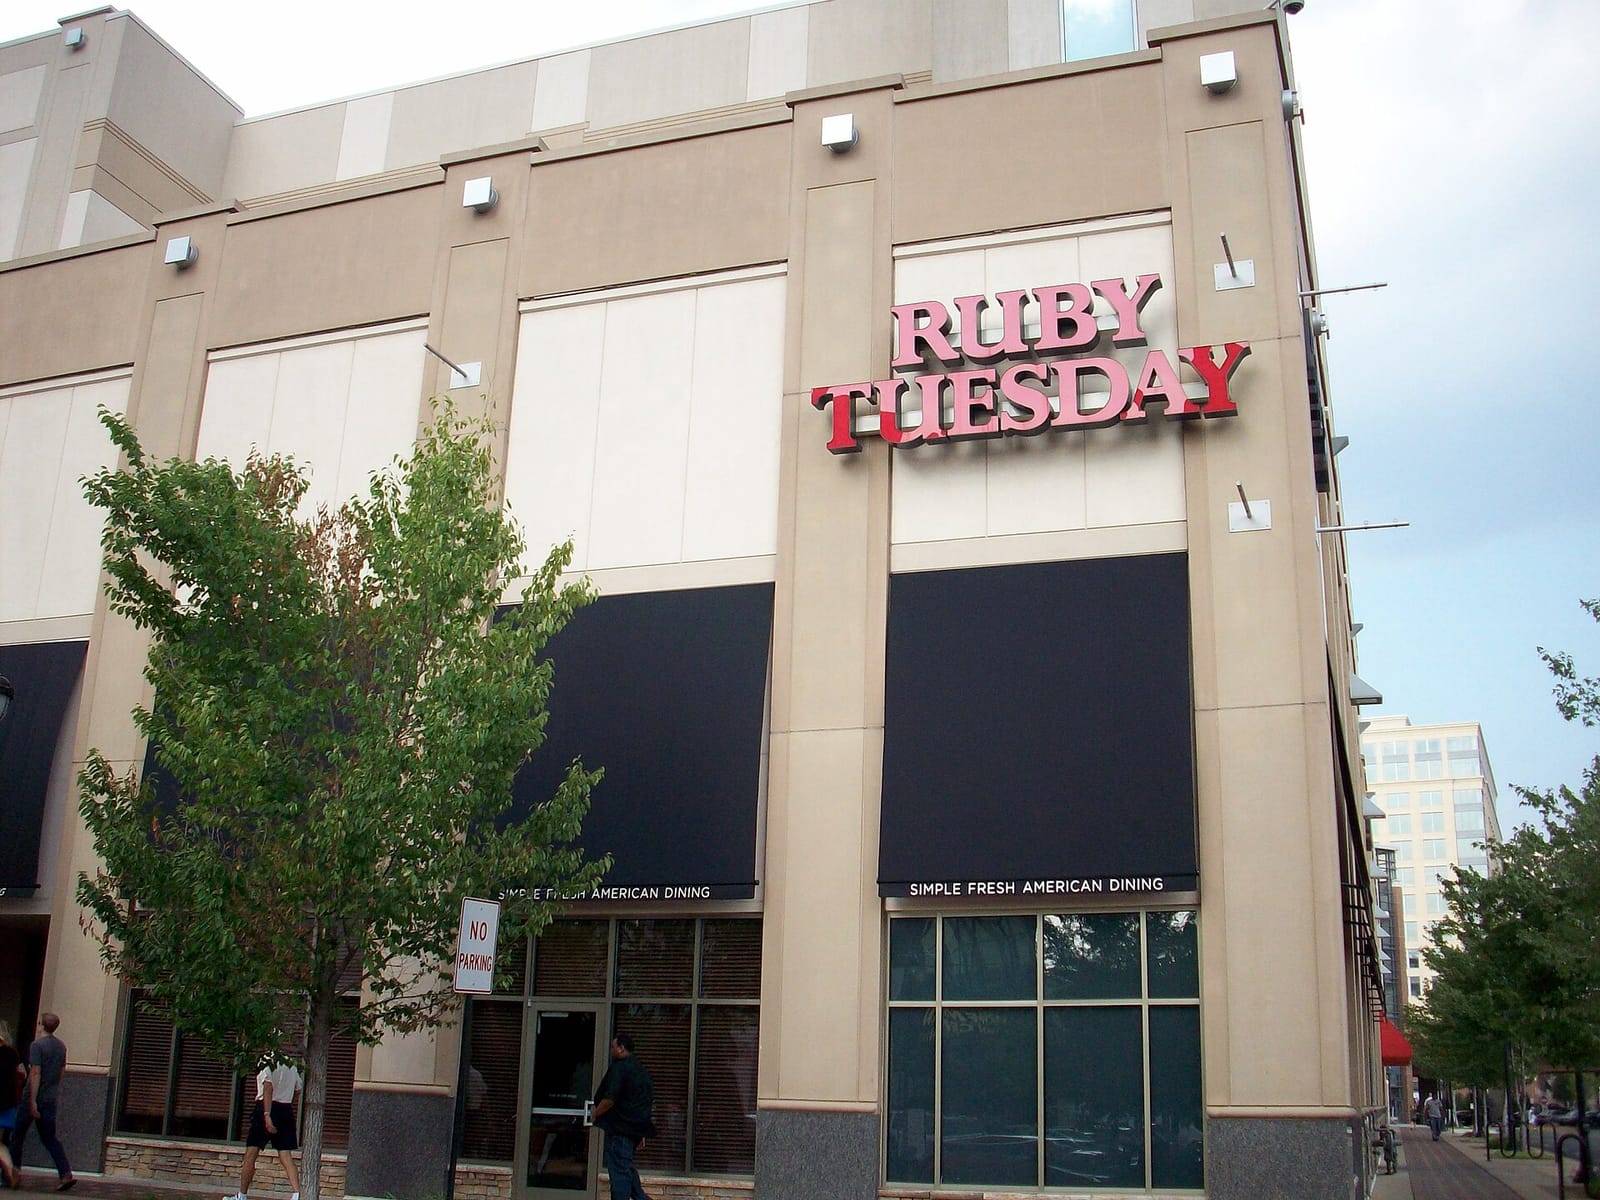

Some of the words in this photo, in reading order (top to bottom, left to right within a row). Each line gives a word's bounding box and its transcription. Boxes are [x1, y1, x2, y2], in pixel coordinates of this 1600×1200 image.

[891, 273, 1162, 373] RUBY
[811, 341, 1252, 455] TUESDAY
[498, 888, 541, 900] SMPE
[591, 887, 659, 900] AMERICAN
[664, 886, 711, 899] DINING
[910, 882, 961, 896] SIMPLE
[967, 881, 1015, 895] FRESH
[1022, 879, 1103, 894] AMERICAN
[1109, 877, 1164, 892] DINING
[469, 920, 488, 941] NO
[459, 953, 493, 972] PARKING
